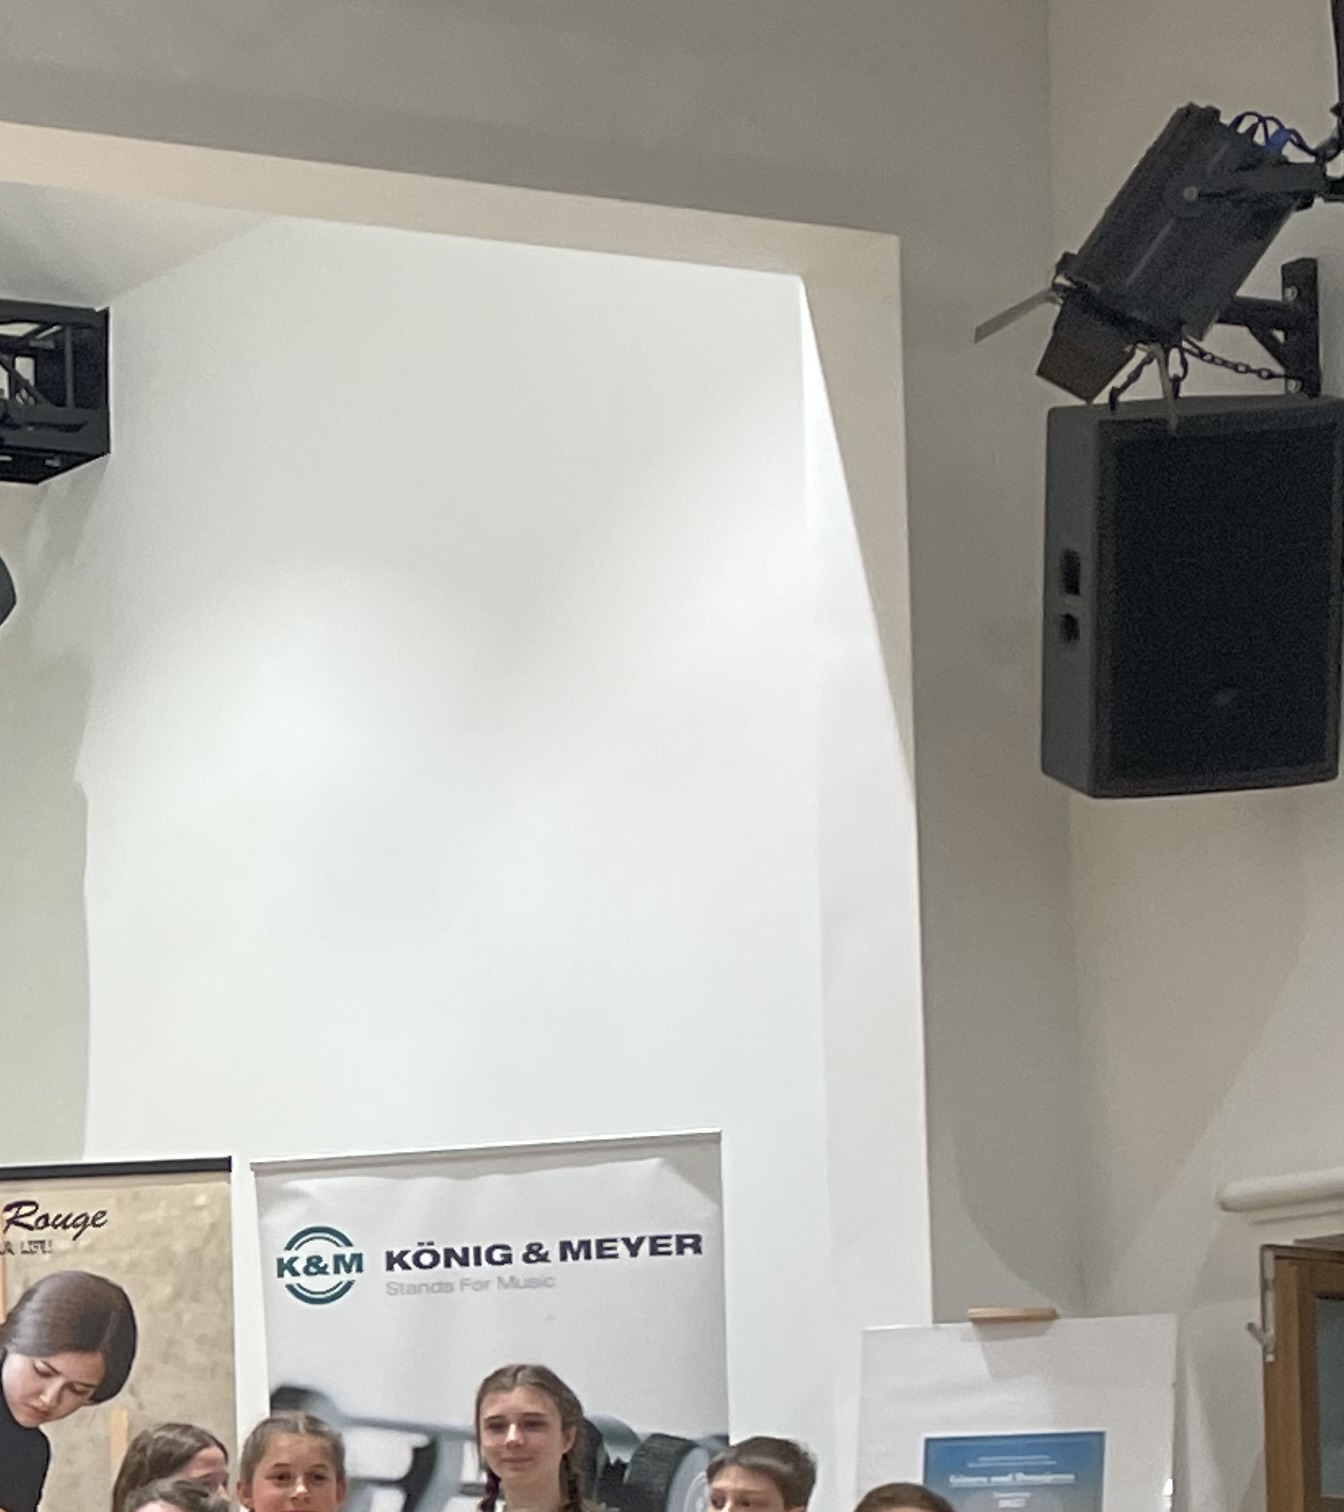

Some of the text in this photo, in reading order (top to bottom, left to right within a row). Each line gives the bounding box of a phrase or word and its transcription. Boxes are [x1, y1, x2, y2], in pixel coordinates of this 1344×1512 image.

[2, 1200, 109, 1241] Rouge
[276, 1252, 364, 1279] K&M
[386, 1233, 703, 1272] KÖNIG & MEYER
[386, 1273, 556, 1296] Stands For Music
